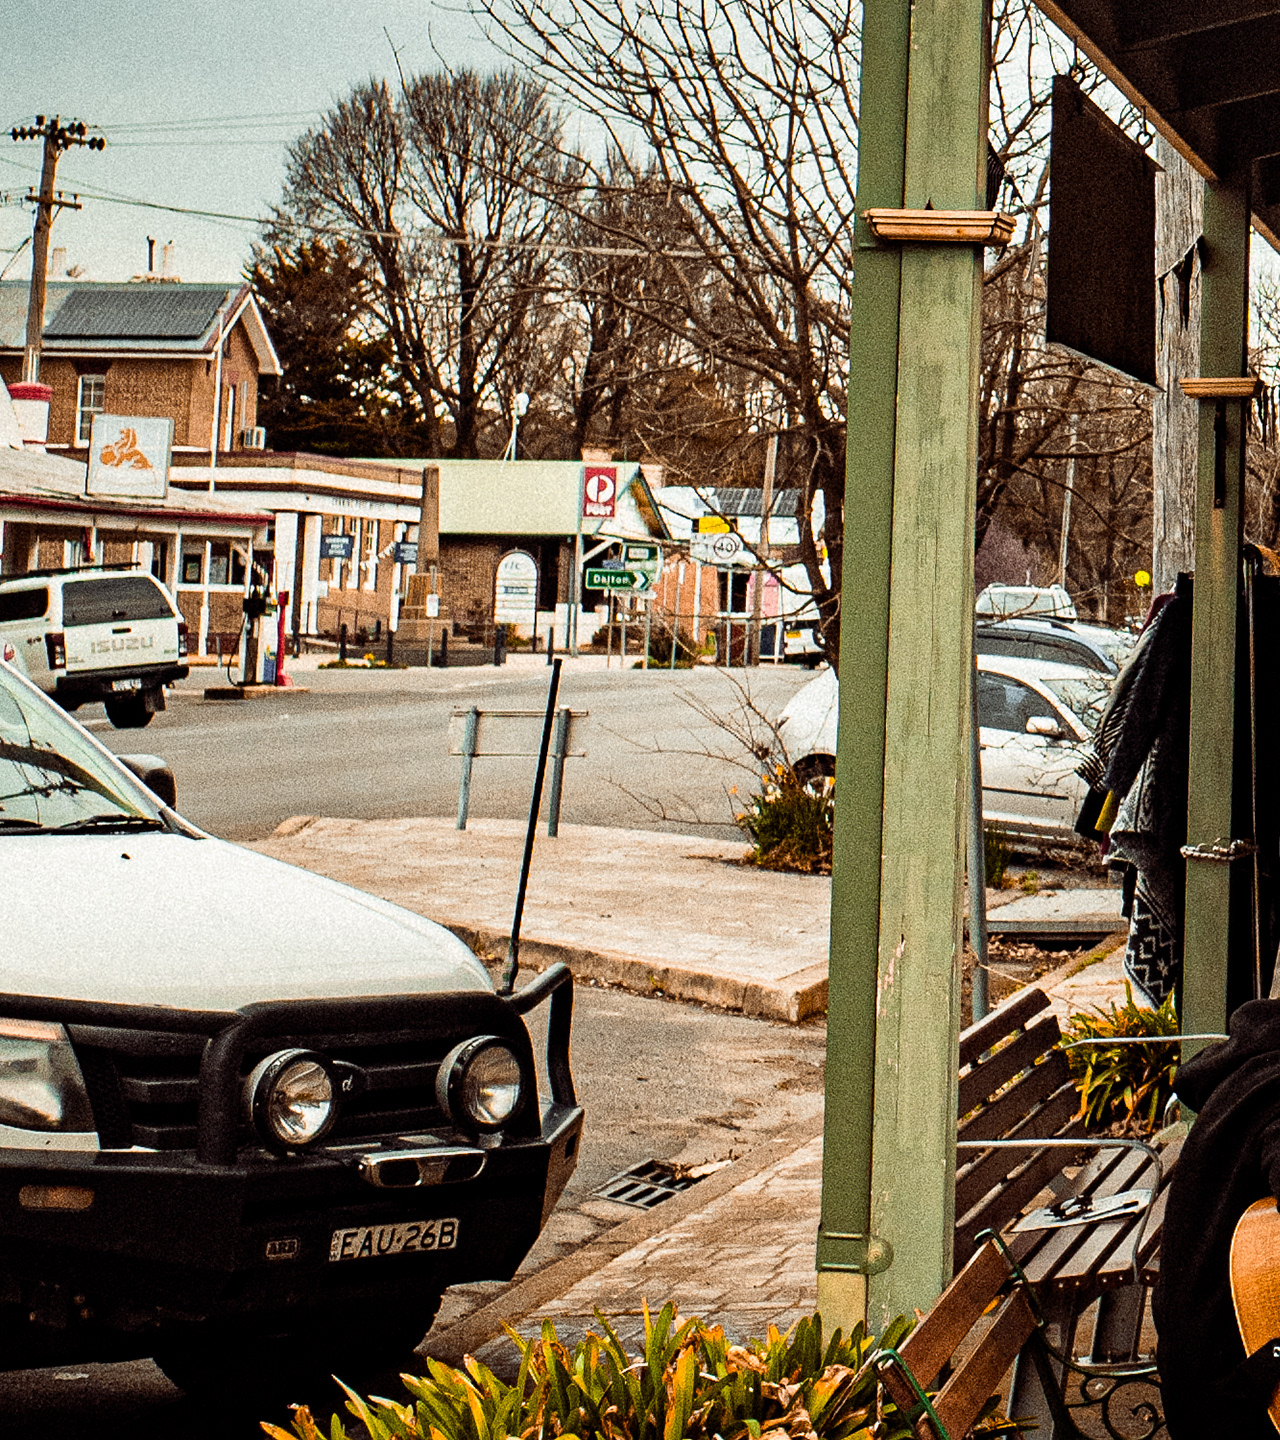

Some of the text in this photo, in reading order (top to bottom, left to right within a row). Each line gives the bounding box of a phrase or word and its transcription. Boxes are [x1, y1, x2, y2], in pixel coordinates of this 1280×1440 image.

[586, 503, 613, 516] POST
[716, 542, 734, 553] 40
[593, 574, 630, 584] Dalton
[91, 635, 154, 654] ISUZU
